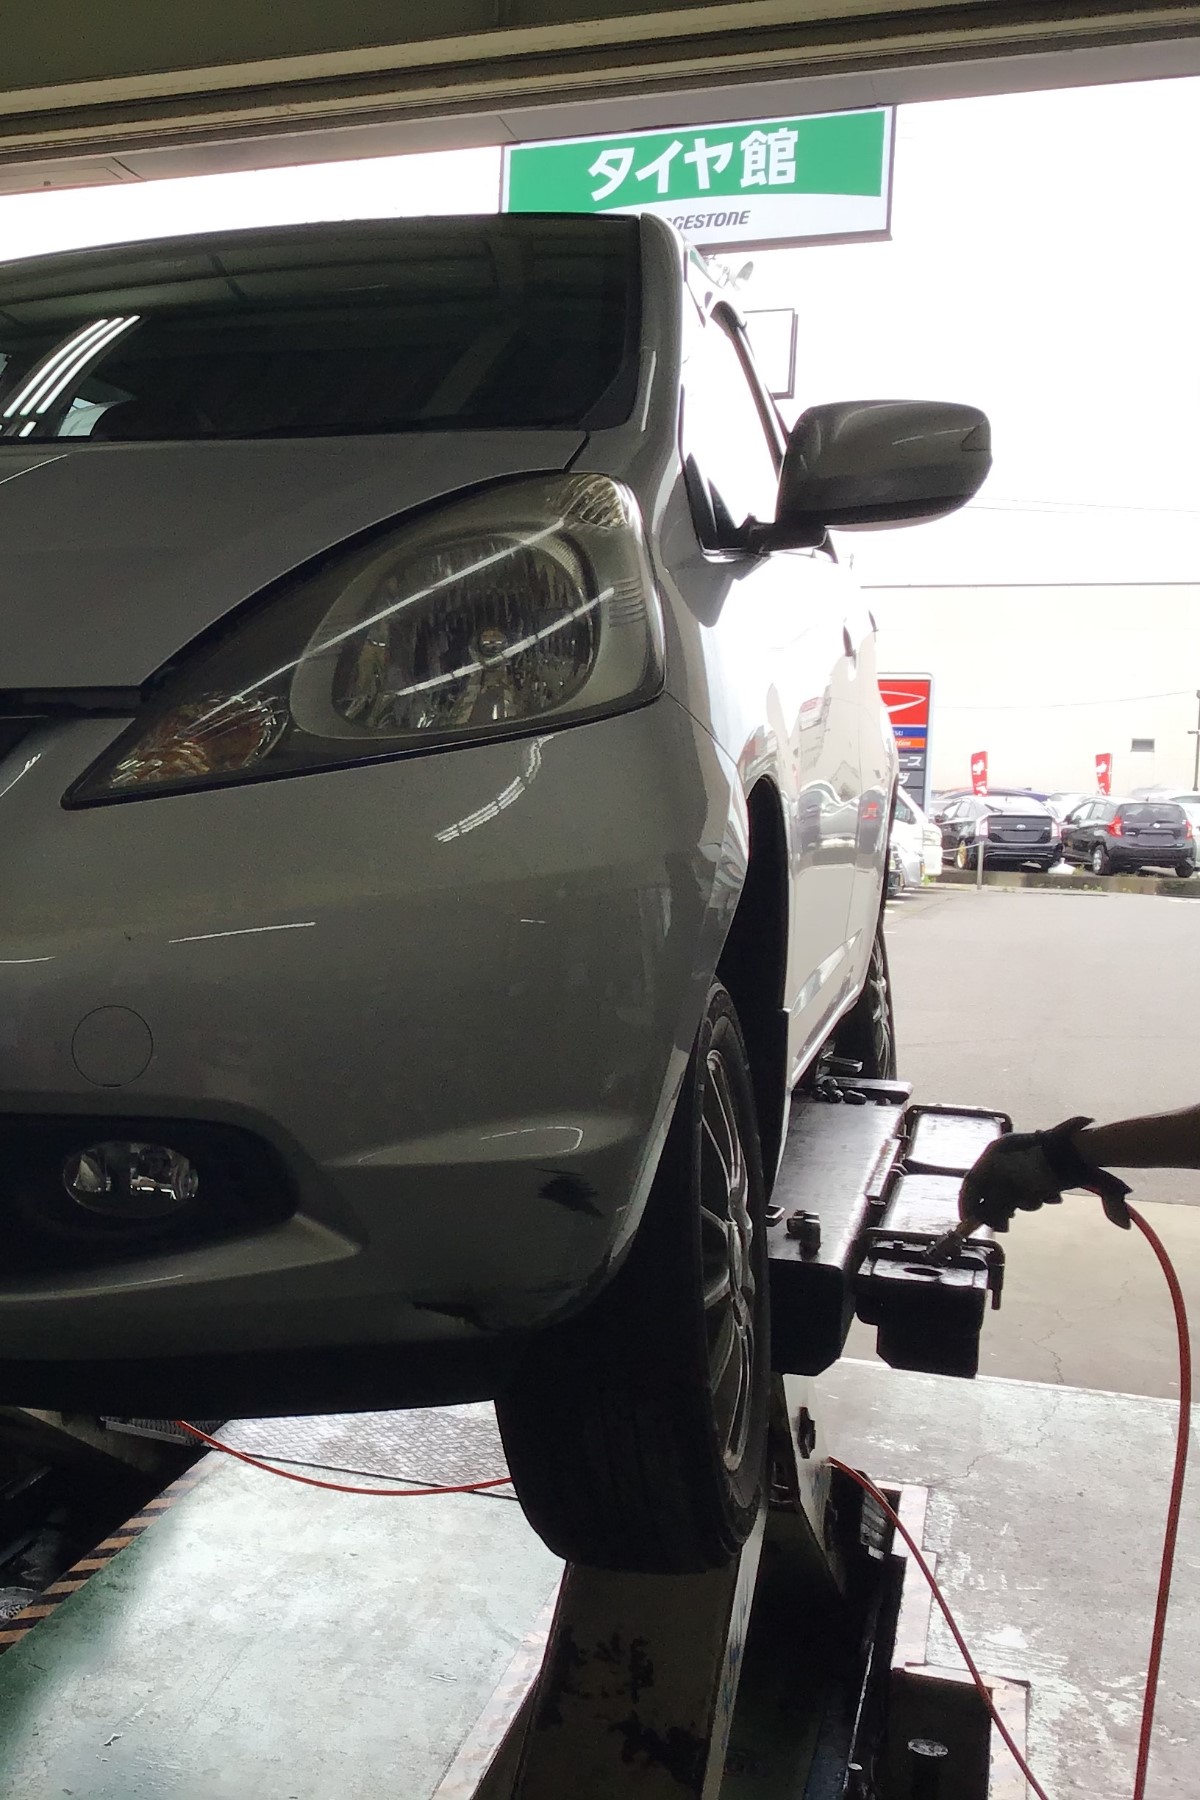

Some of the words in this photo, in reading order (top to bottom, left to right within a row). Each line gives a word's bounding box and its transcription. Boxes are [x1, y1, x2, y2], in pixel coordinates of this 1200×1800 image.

[588, 127, 799, 202] タイヤ館
[666, 210, 751, 230] GESTONE
